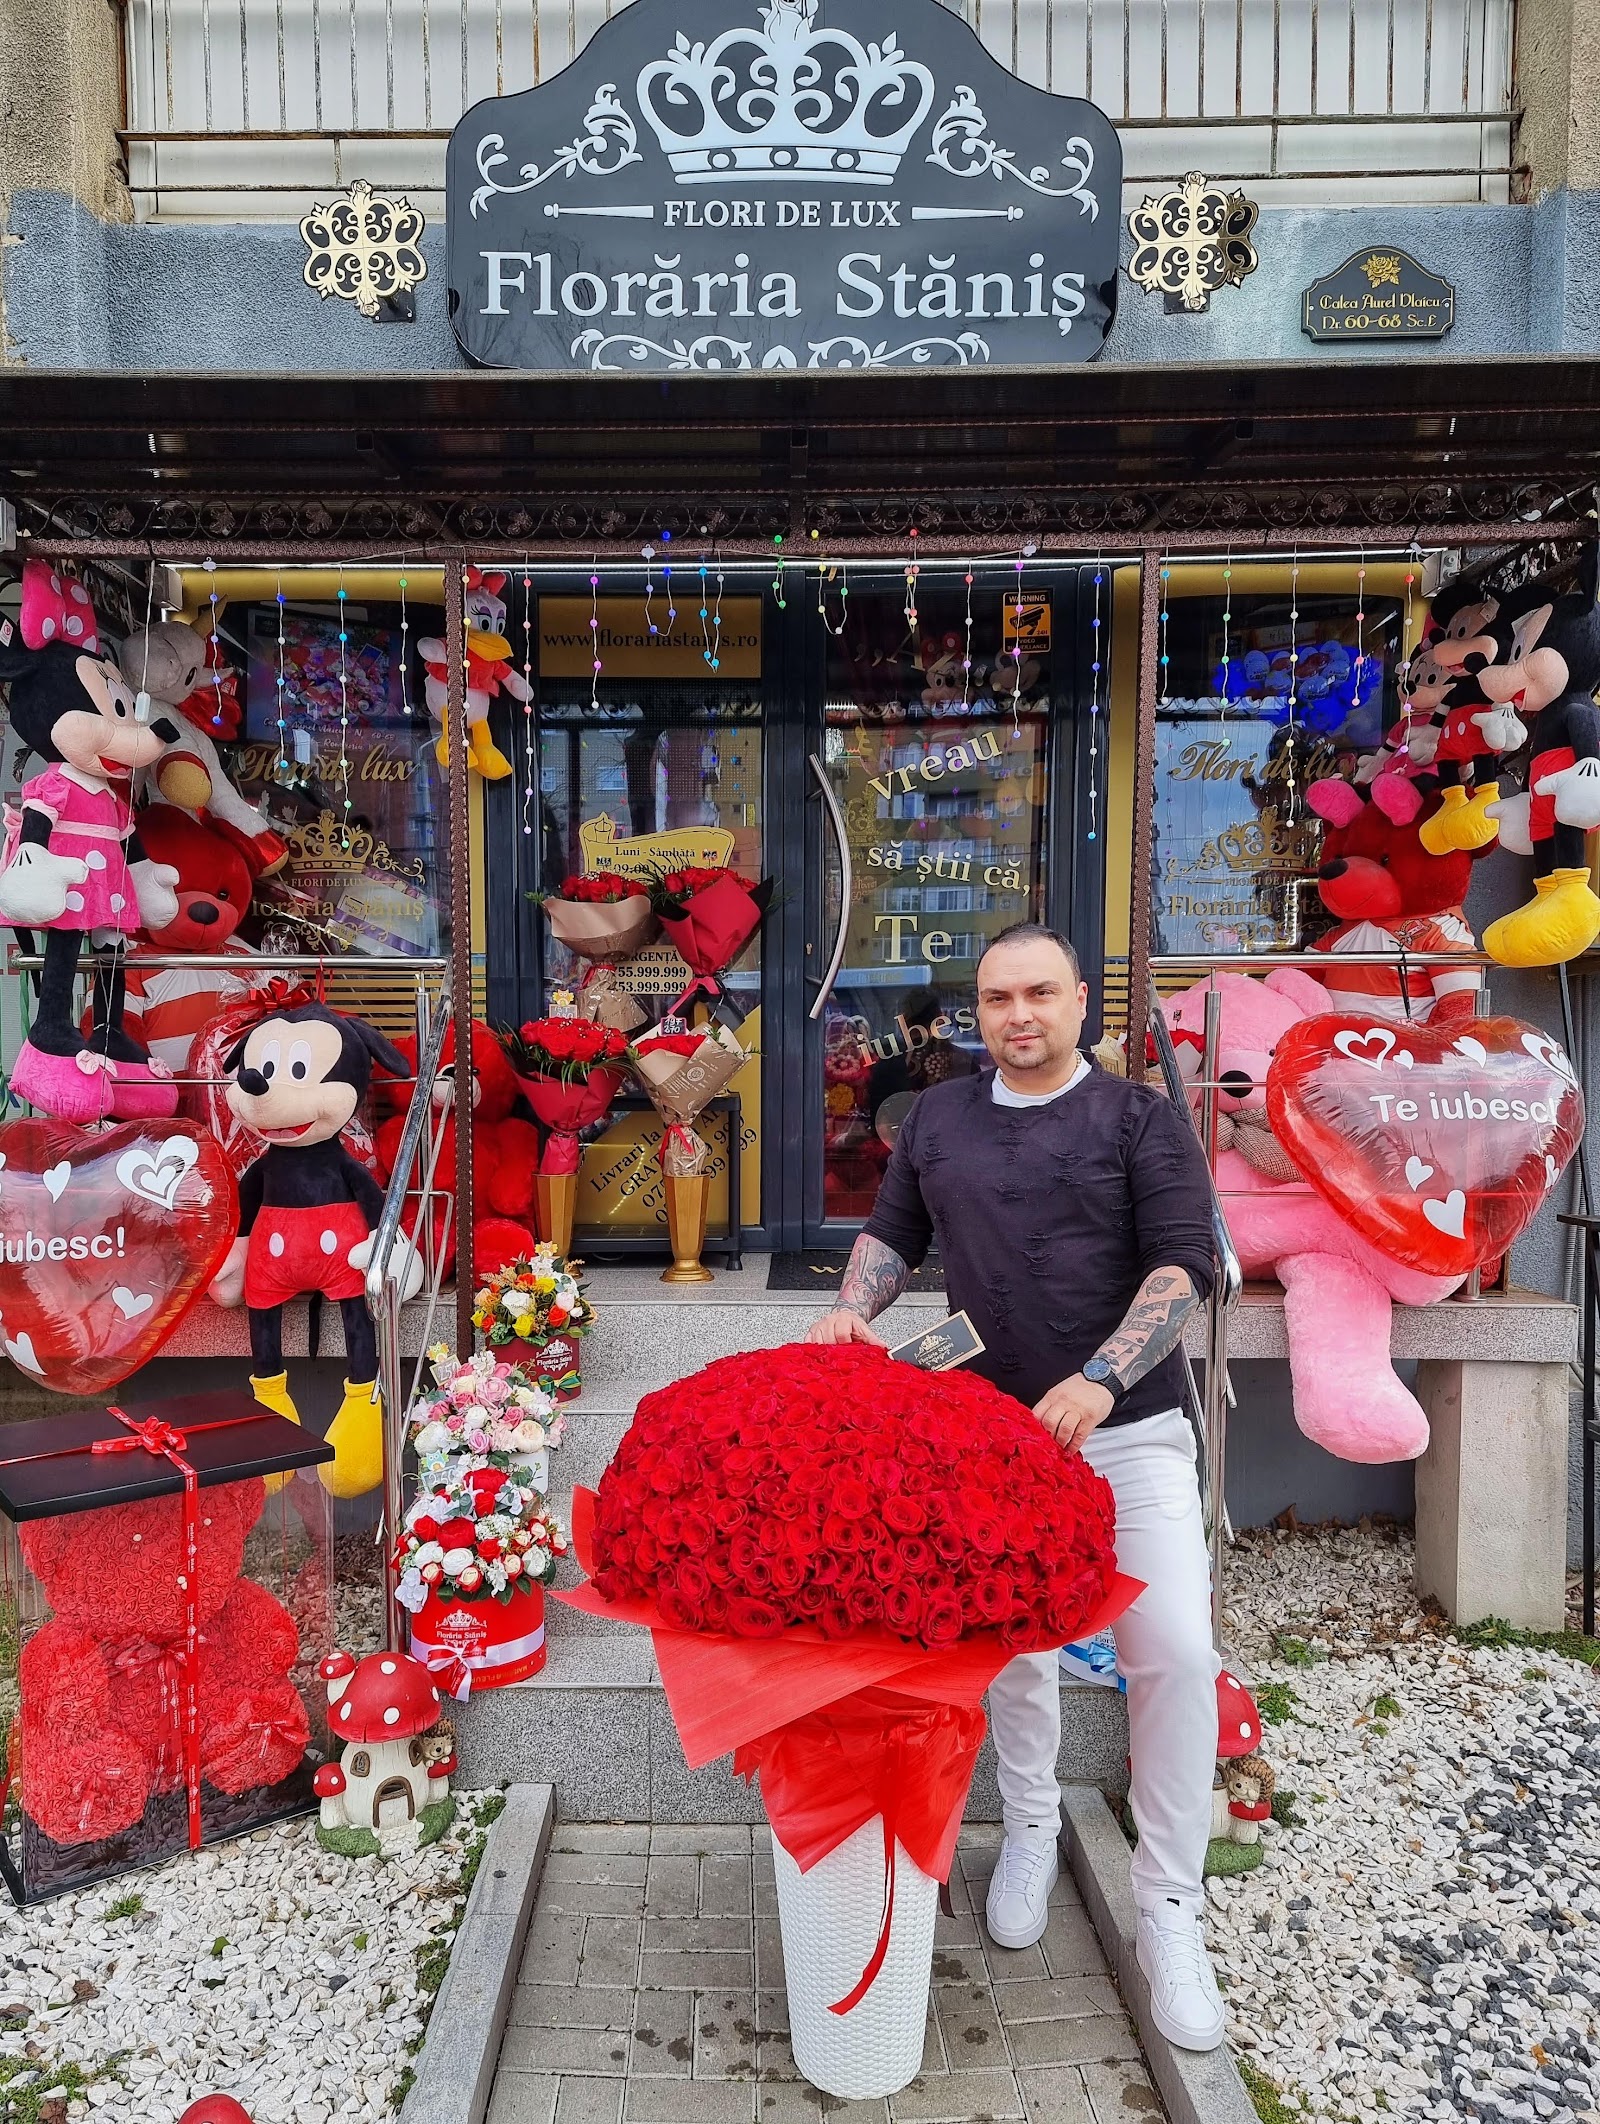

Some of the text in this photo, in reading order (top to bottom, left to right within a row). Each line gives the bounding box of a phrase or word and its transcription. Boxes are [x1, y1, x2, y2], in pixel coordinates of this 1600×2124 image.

[663, 201, 901, 227] FLORI DE LUX
[479, 251, 1086, 337] Florăria Stăniș
[1319, 293, 1441, 311] Calea Aurel Vlaicu
[1322, 315, 1342, 330] Nr.
[1344, 314, 1402, 330] 60-68
[543, 628, 758, 648] wwwflorariastans.ro
[360, 743, 420, 782] lux
[867, 730, 1003, 801] vreau
[1167, 740, 1259, 782] Flori
[1259, 747, 1298, 781] de
[615, 846, 640, 856] Luni
[866, 839, 1031, 897] să știi că,
[1265, 876, 1280, 886] DE
[291, 878, 324, 887] FLORI
[326, 878, 341, 887] DE
[874, 915, 953, 964] Te
[631, 950, 679, 964] RGENȚĂ
[615, 966, 687, 978] 55.999.999
[615, 981, 687, 993] 53.999.999
[857, 1005, 978, 1068] iubes
[1369, 1093, 1419, 1123] Te
[590, 1142, 646, 1193] Livrari
[641, 1130, 662, 1146] la
